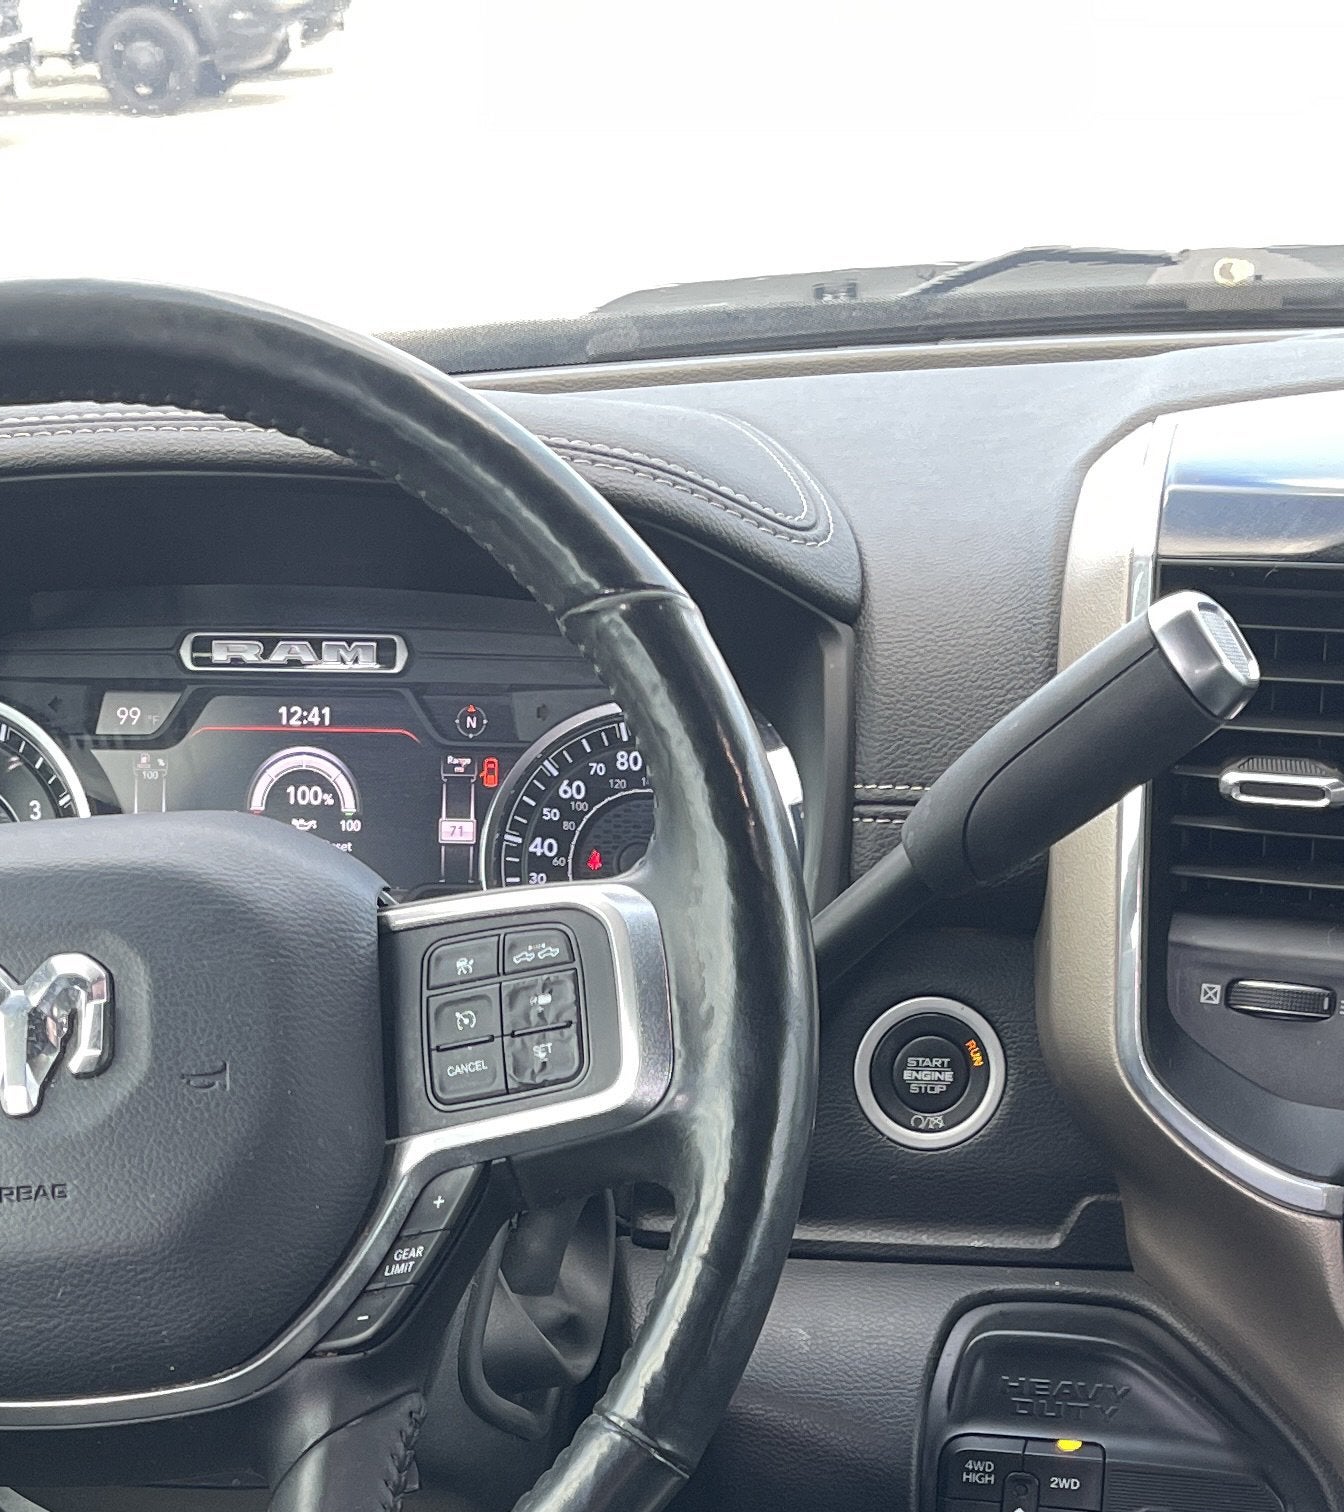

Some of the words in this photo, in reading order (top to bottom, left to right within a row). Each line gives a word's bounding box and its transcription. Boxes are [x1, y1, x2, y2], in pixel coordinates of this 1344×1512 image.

[212, 640, 377, 665] RAM
[116, 707, 141, 725] 99
[278, 706, 331, 726] 12:41
[615, 751, 643, 771] 80
[588, 762, 606, 776] 70
[558, 780, 586, 799] 60
[609, 779, 627, 790] 120
[29, 800, 41, 821] 3
[570, 801, 589, 812] 100
[542, 808, 560, 821] 50
[340, 819, 362, 832] 100
[450, 825, 463, 836] 71
[562, 821, 576, 830] 80
[529, 837, 558, 857] 40
[552, 857, 566, 867] 60
[529, 873, 547, 885] 30
[964, 1039, 985, 1067] RUN
[447, 1060, 488, 1077] CANCEL
[907, 1057, 950, 1068] START
[903, 1071, 954, 1082] ENGINE
[910, 1084, 947, 1094] STOP
[394, 1246, 424, 1261] GEAR
[384, 1261, 415, 1277] LIMIT
[1001, 1376, 1131, 1400] HEAVY
[1010, 1397, 1119, 1419] DUTY
[964, 1460, 995, 1473] 4WD
[962, 1472, 995, 1485] HIGH
[1050, 1477, 1080, 1490] 2WD
